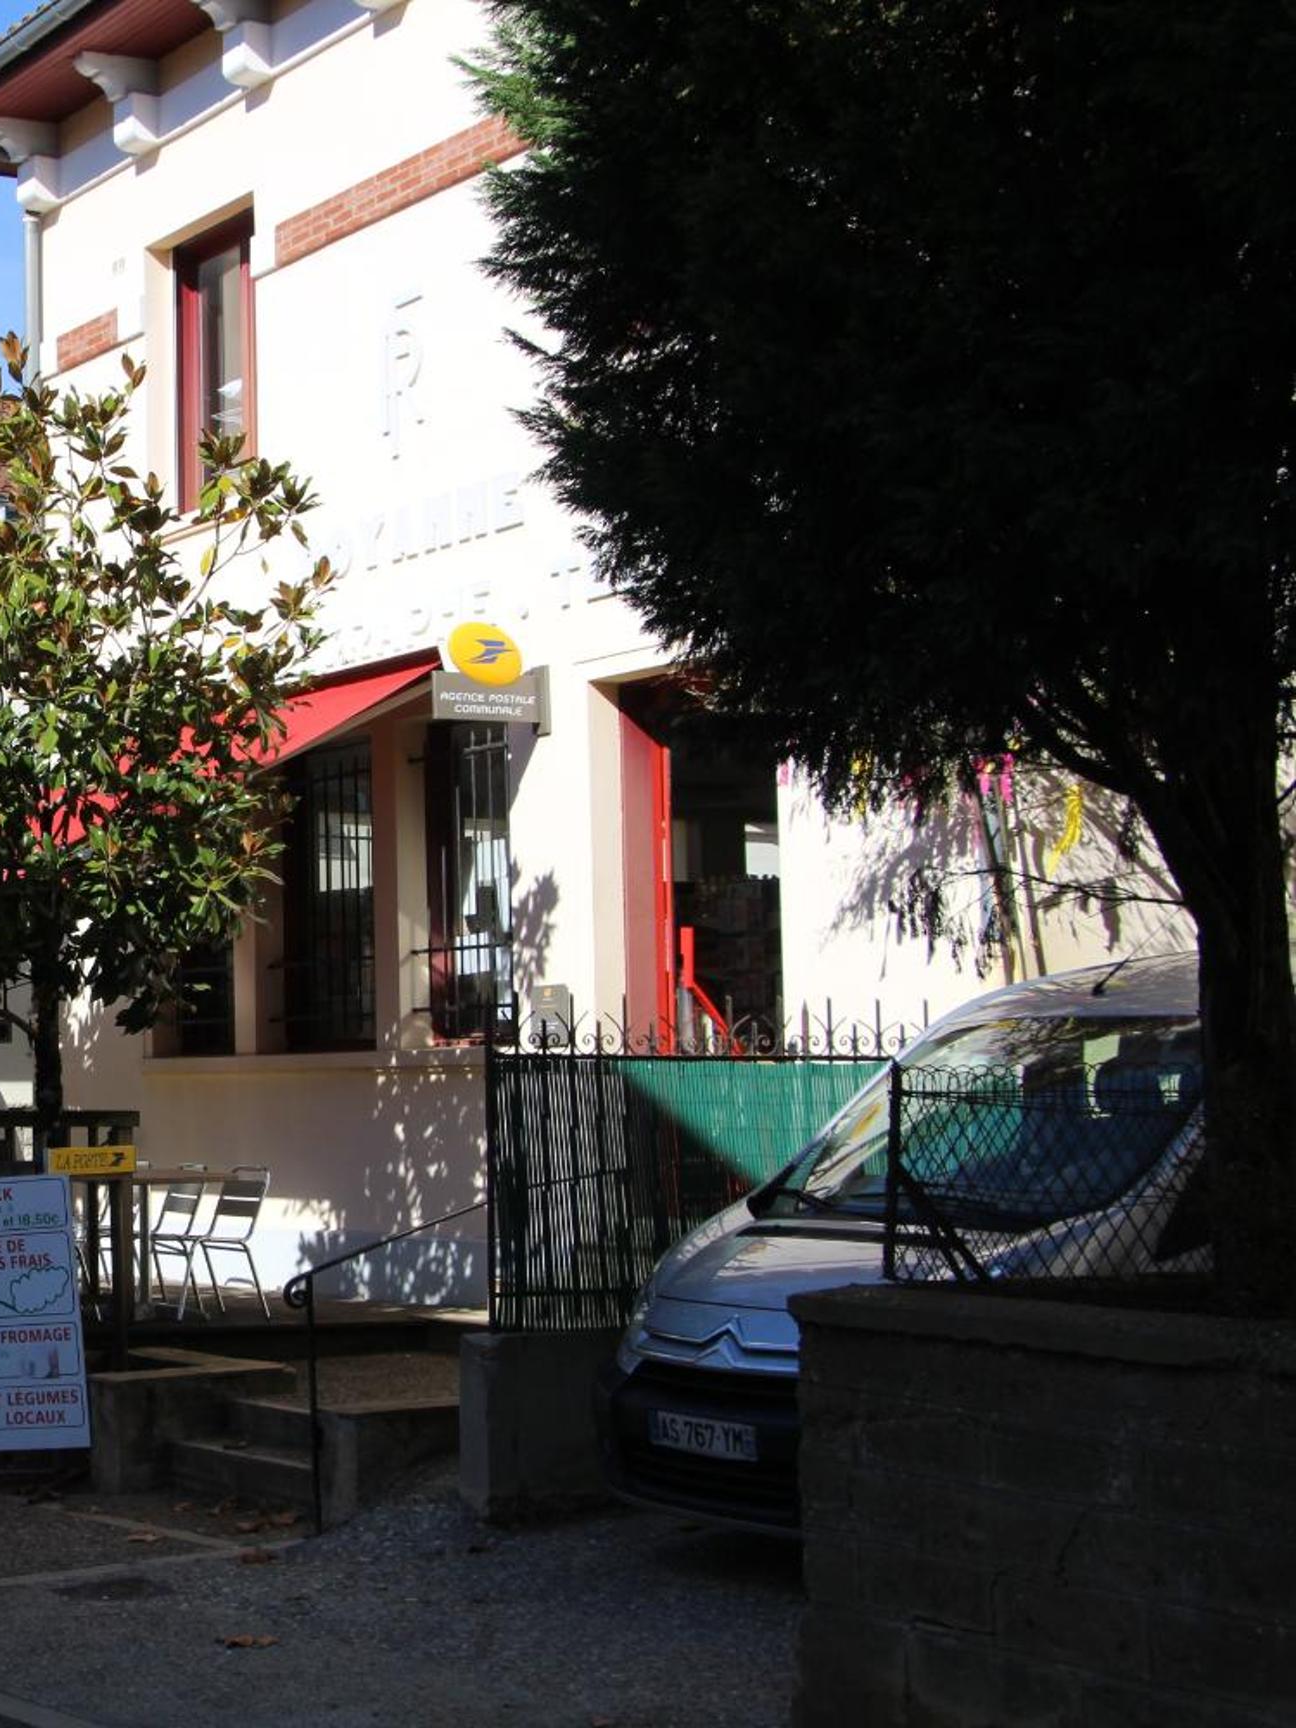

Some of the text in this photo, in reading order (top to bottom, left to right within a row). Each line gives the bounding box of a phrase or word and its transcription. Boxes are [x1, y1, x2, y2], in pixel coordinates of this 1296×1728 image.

[439, 691, 537, 705] AGENCE POSTALE
[454, 704, 524, 716] COMMUNALE
[6, 1238, 25, 1253] DE
[10, 1253, 53, 1270] FRAIS
[0, 1327, 72, 1344] FROMAGE
[5, 1410, 67, 1425] LOCAUX
